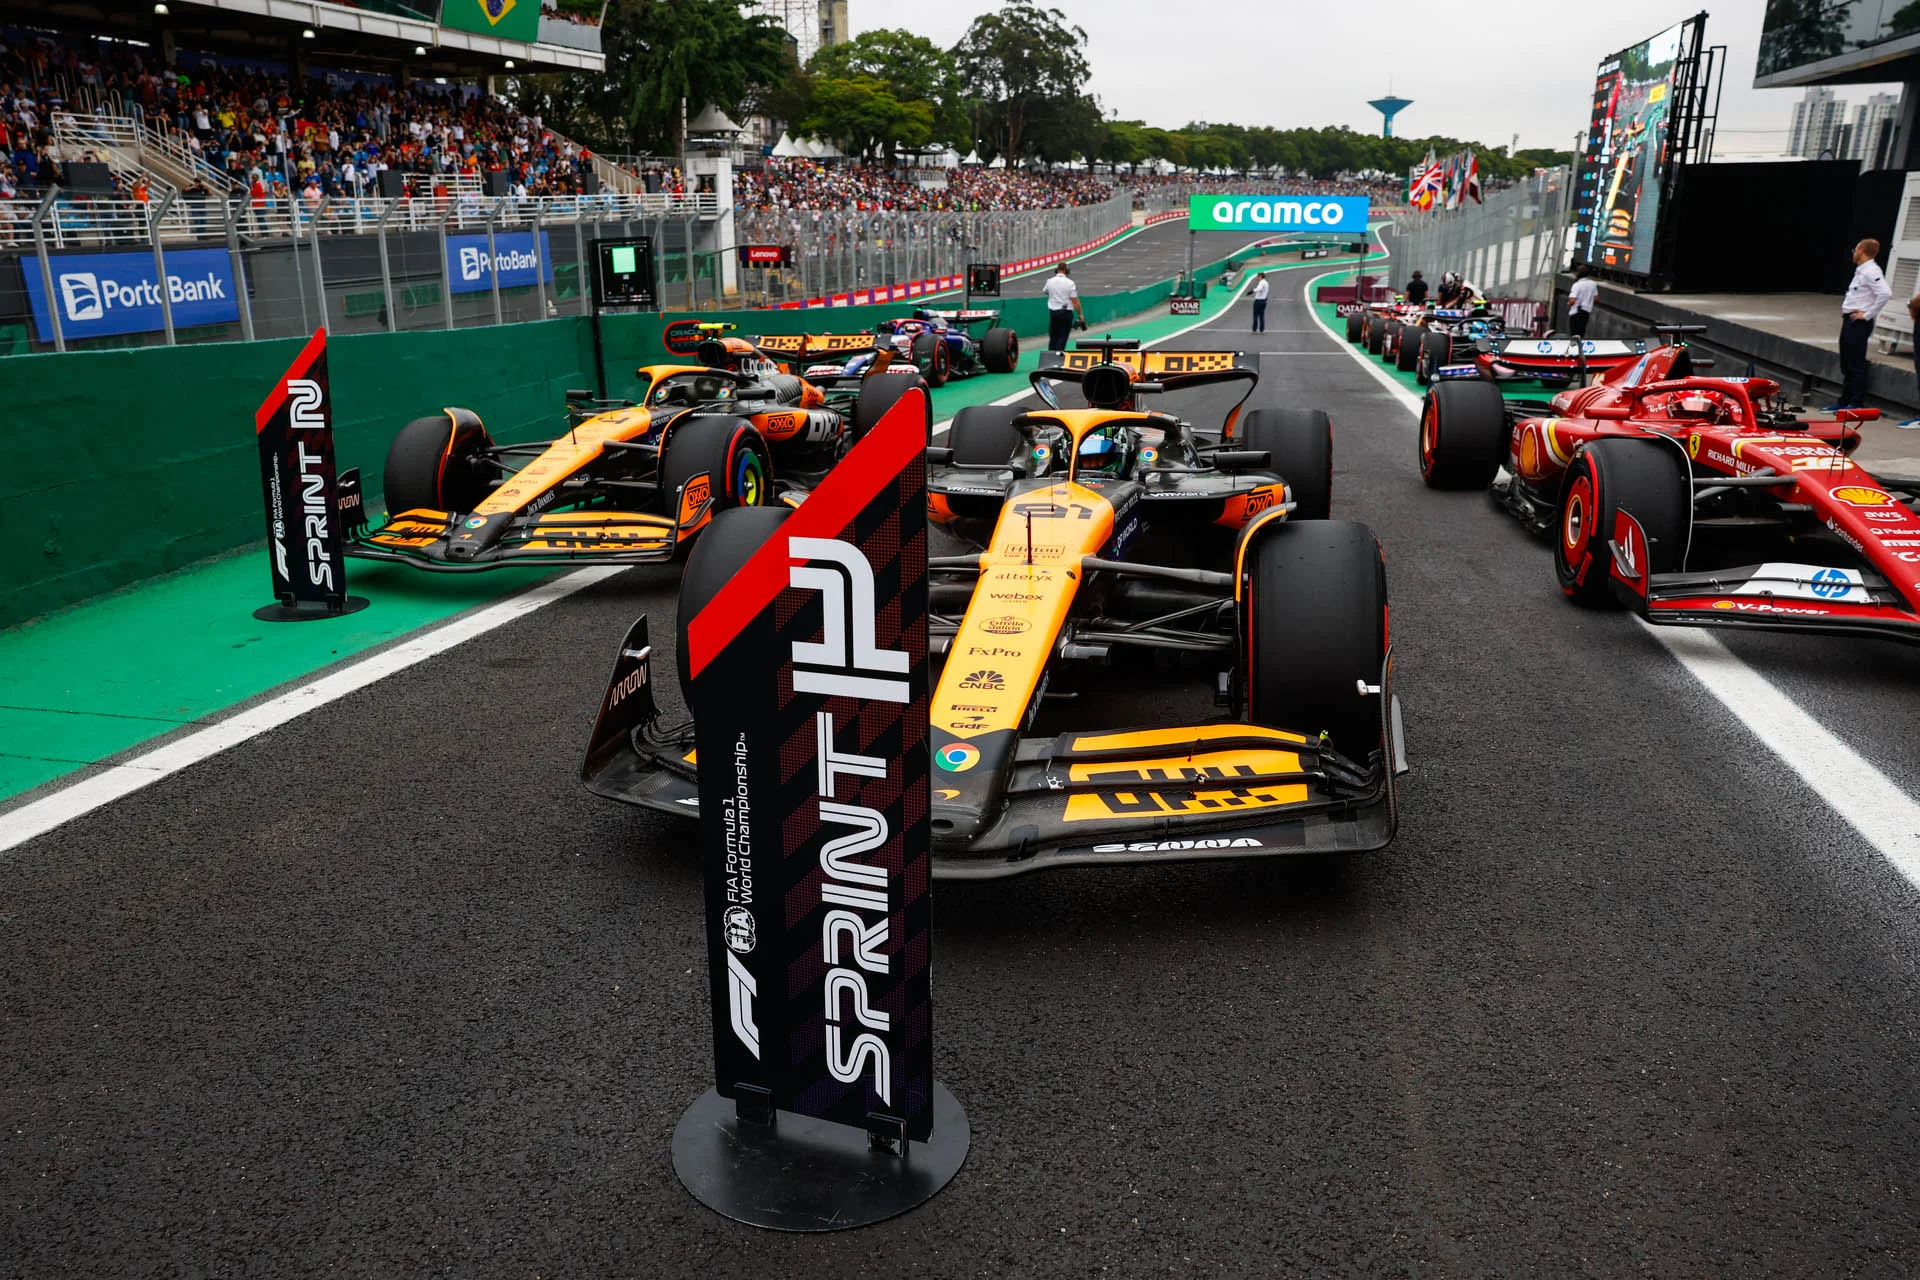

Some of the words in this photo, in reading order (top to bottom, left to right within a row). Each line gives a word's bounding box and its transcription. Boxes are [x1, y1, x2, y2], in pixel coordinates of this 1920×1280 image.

[1213, 201, 1343, 225] aramco
[751, 250, 777, 258] Lenovo
[1171, 302, 1199, 310] QATAR
[287, 379, 325, 428] 2
[768, 417, 795, 431] OXXO
[1708, 449, 1735, 467] RICHARD
[1735, 460, 1756, 474] MILLE
[1791, 456, 1854, 472] 16
[688, 484, 710, 505] OXXO
[298, 441, 334, 592] SPRINT
[1013, 503, 1093, 520] 81
[1864, 511, 1904, 519] aws
[995, 573, 1053, 581] alteryx
[1811, 569, 1851, 598] hp
[990, 593, 1044, 601] webex
[1737, 603, 1830, 616] V-Power
[788, 536, 910, 704] 1
[968, 647, 1022, 658] FxPro
[958, 682, 1006, 691] CNBC
[951, 704, 999, 713] PIRELLI
[722, 797, 735, 806] 1
[723, 808, 737, 874] Formula
[1093, 838, 1264, 853] SENNA
[739, 857, 753, 904] World
[727, 877, 739, 902] FIA
[817, 711, 891, 1108] SPRINT
